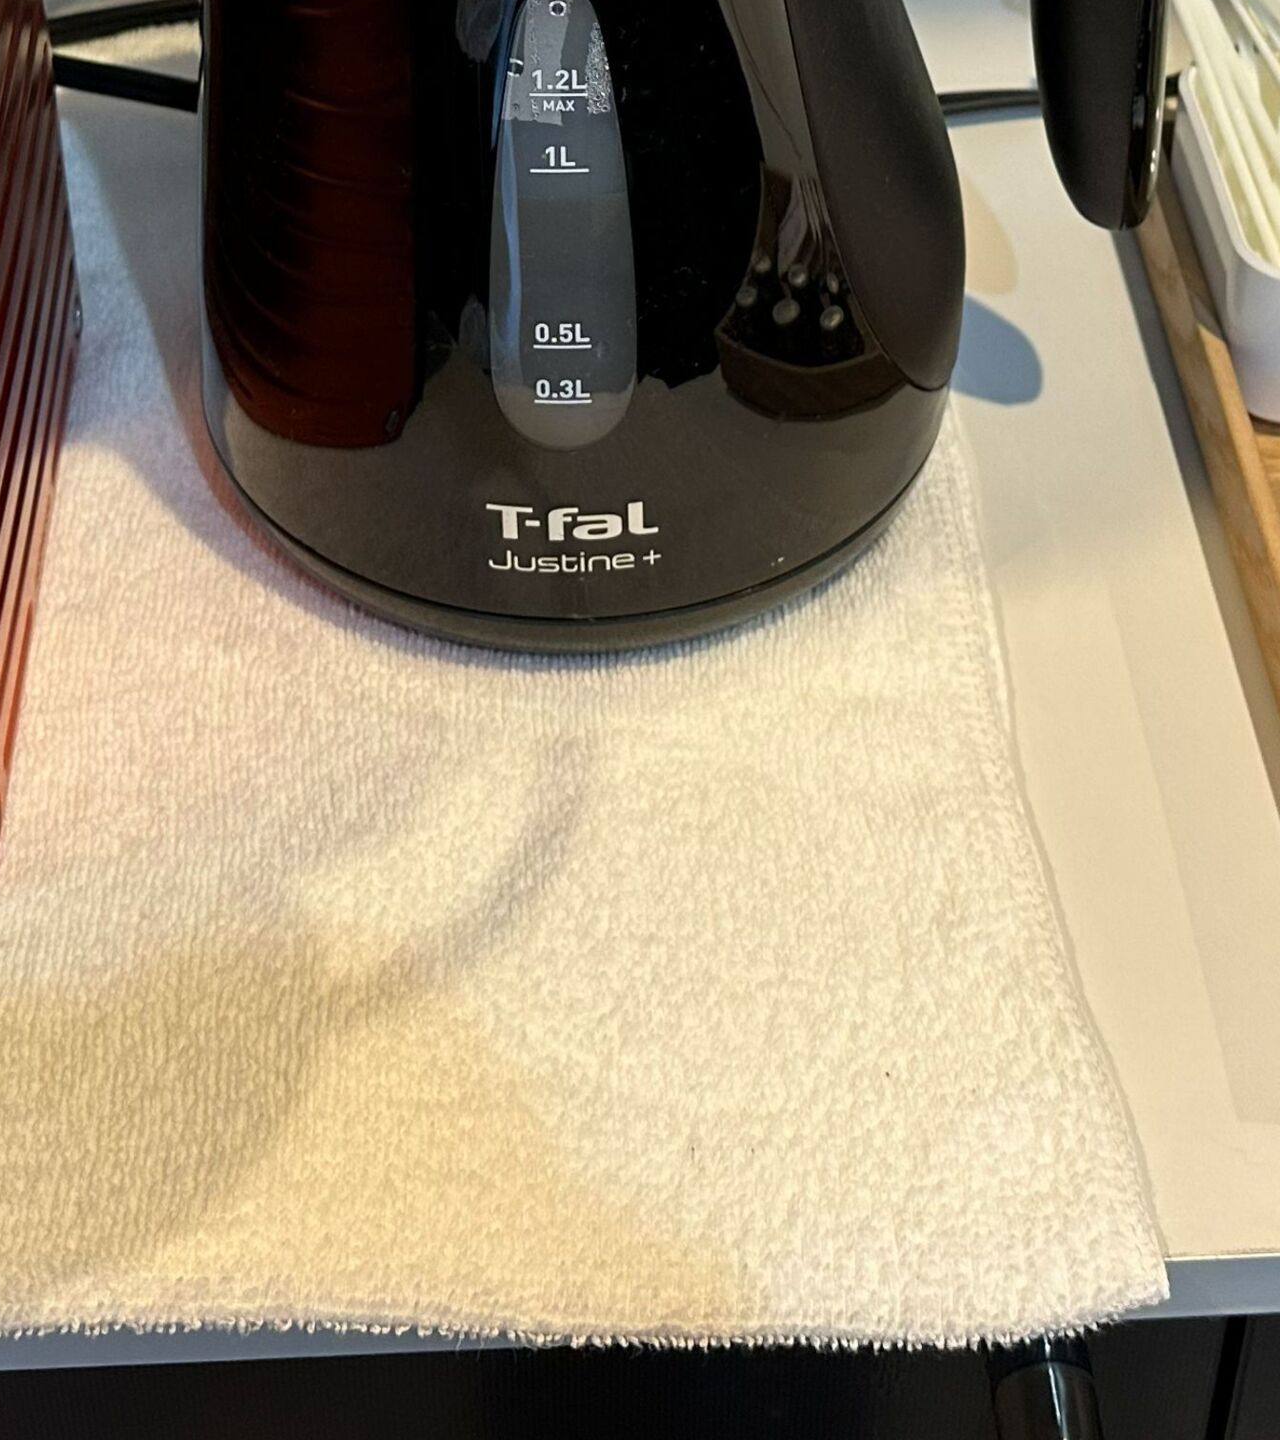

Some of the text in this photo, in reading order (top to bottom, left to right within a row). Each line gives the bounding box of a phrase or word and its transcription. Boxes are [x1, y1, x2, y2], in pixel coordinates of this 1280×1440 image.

[531, 69, 588, 90] 1.2L
[543, 100, 575, 111] MAX
[545, 146, 576, 167] 1L
[535, 323, 590, 343] 0.5L
[536, 379, 590, 398] 0.3L
[486, 501, 659, 541] T-fal
[488, 550, 635, 572] Justine
